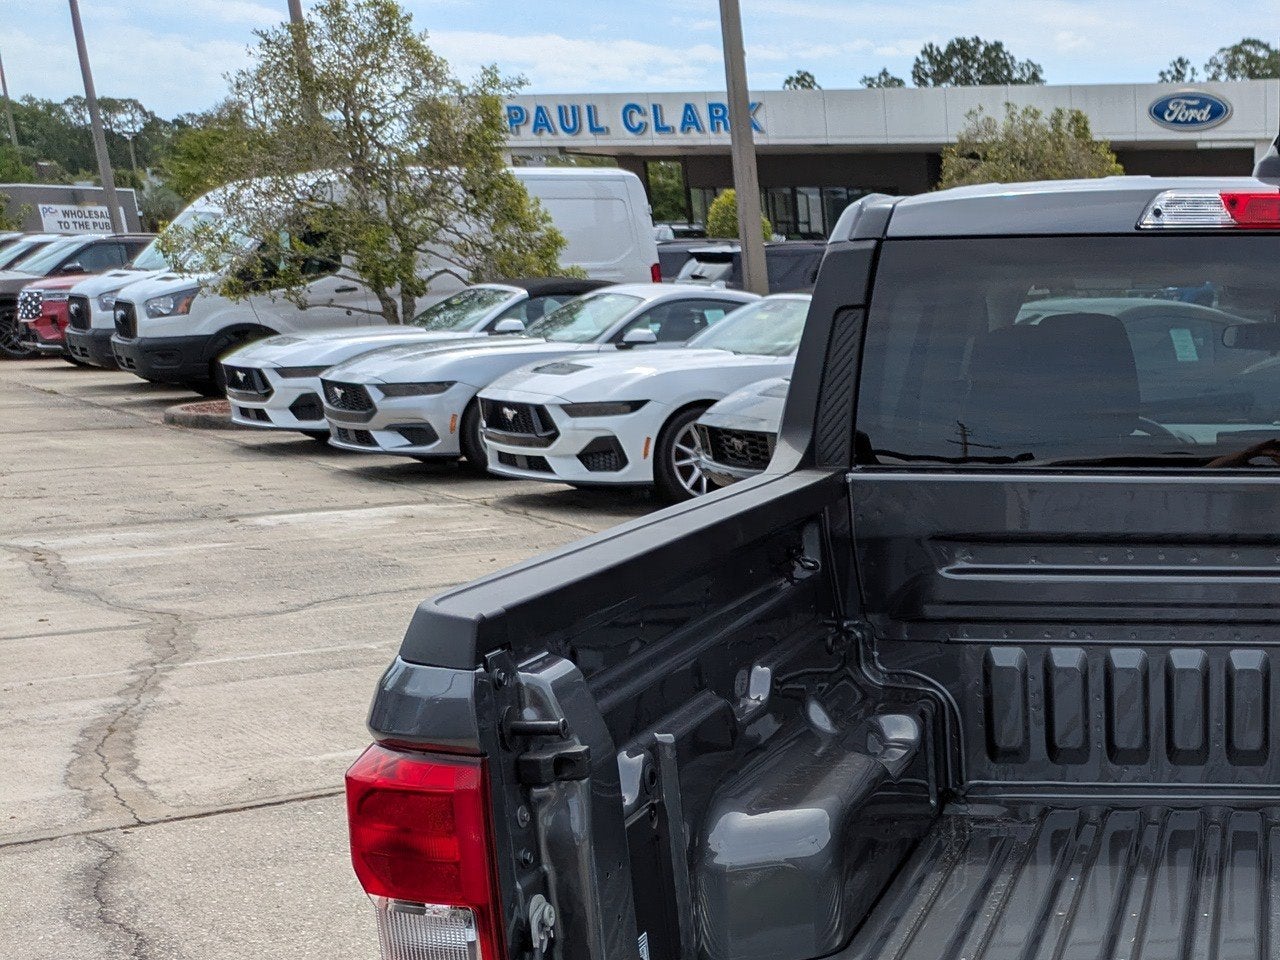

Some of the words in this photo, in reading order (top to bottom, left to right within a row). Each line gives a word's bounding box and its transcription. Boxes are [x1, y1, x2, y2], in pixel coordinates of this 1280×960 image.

[1163, 98, 1212, 122] Ford
[507, 104, 607, 136] PAUL
[61, 209, 110, 220] WHOLESAL
[57, 220, 70, 231] TO
[72, 220, 91, 231] THE
[93, 220, 111, 231] PUB
